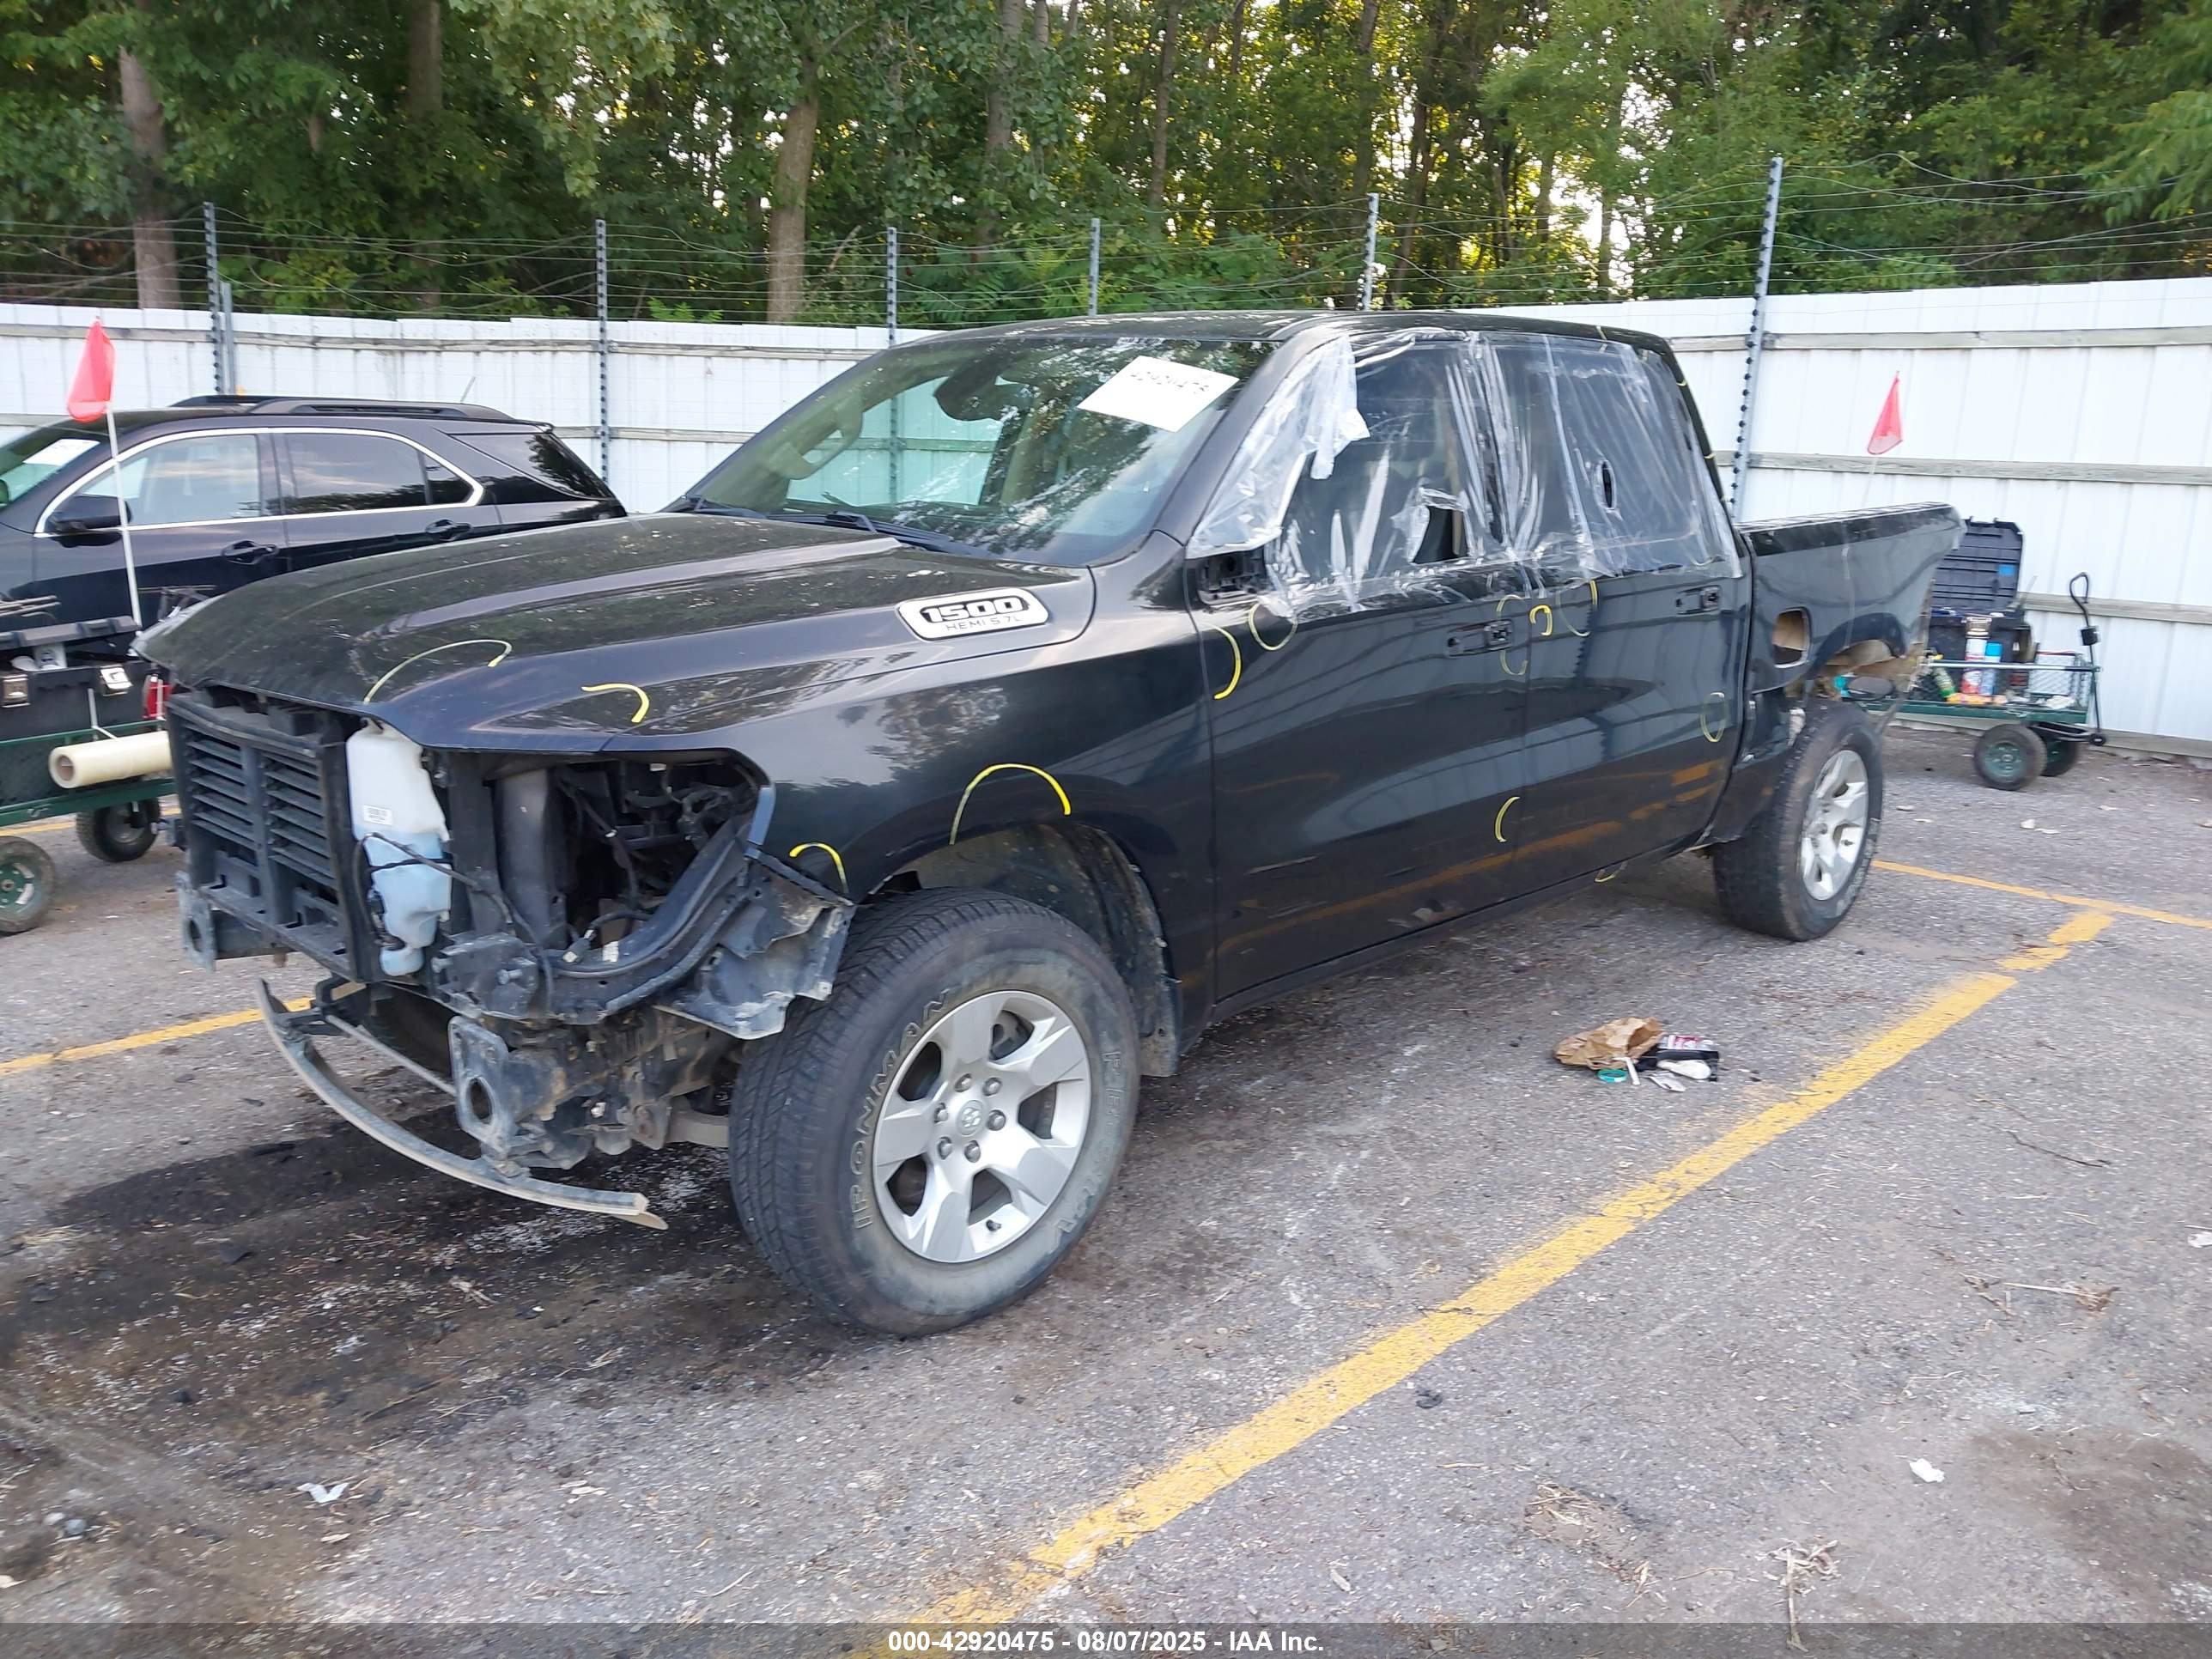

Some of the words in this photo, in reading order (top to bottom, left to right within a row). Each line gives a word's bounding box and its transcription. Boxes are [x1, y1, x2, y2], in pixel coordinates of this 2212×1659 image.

[922, 597, 1024, 623] 1500
[945, 619, 986, 631] HEMI
[990, 616, 1023, 624] 57L
